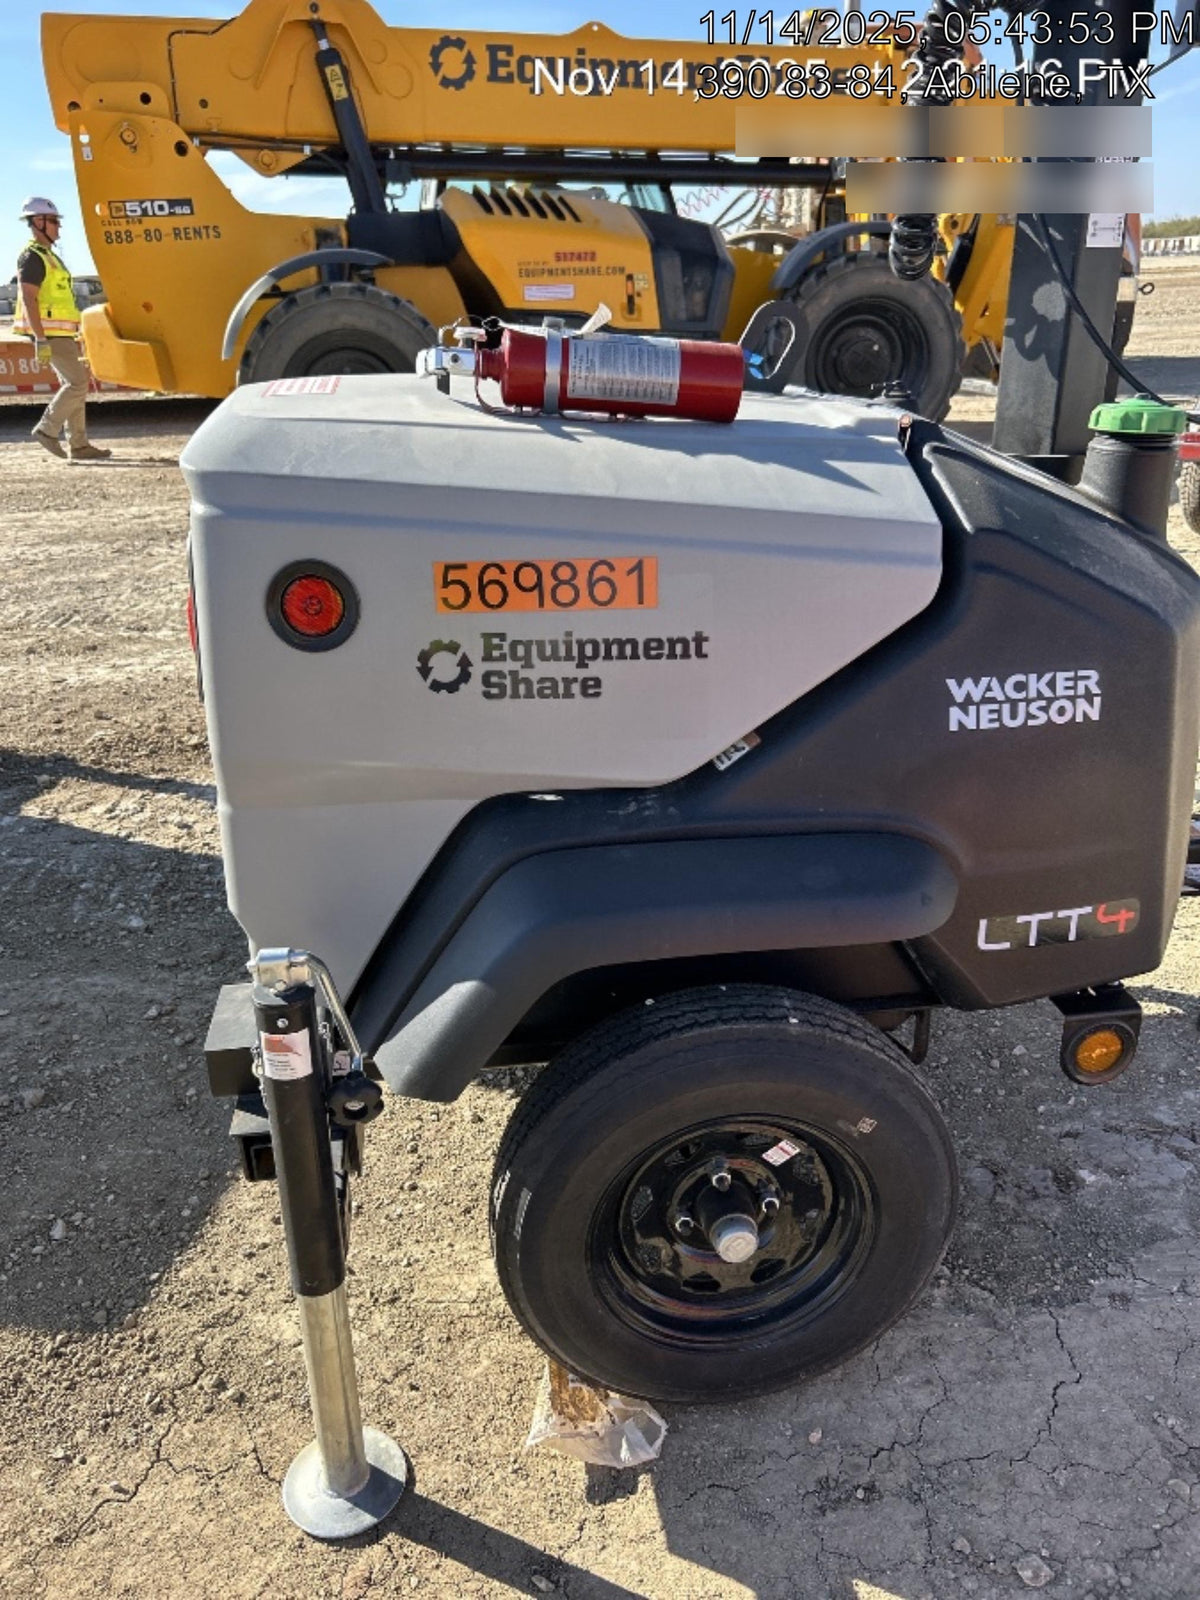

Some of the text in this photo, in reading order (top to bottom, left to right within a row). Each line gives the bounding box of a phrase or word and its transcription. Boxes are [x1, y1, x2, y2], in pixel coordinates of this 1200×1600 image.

[440, 558, 645, 611] 569861
[480, 631, 709, 669] Equipment
[480, 670, 602, 701] Share
[945, 669, 1101, 703] WACKER
[949, 696, 1101, 732] NEUSON
